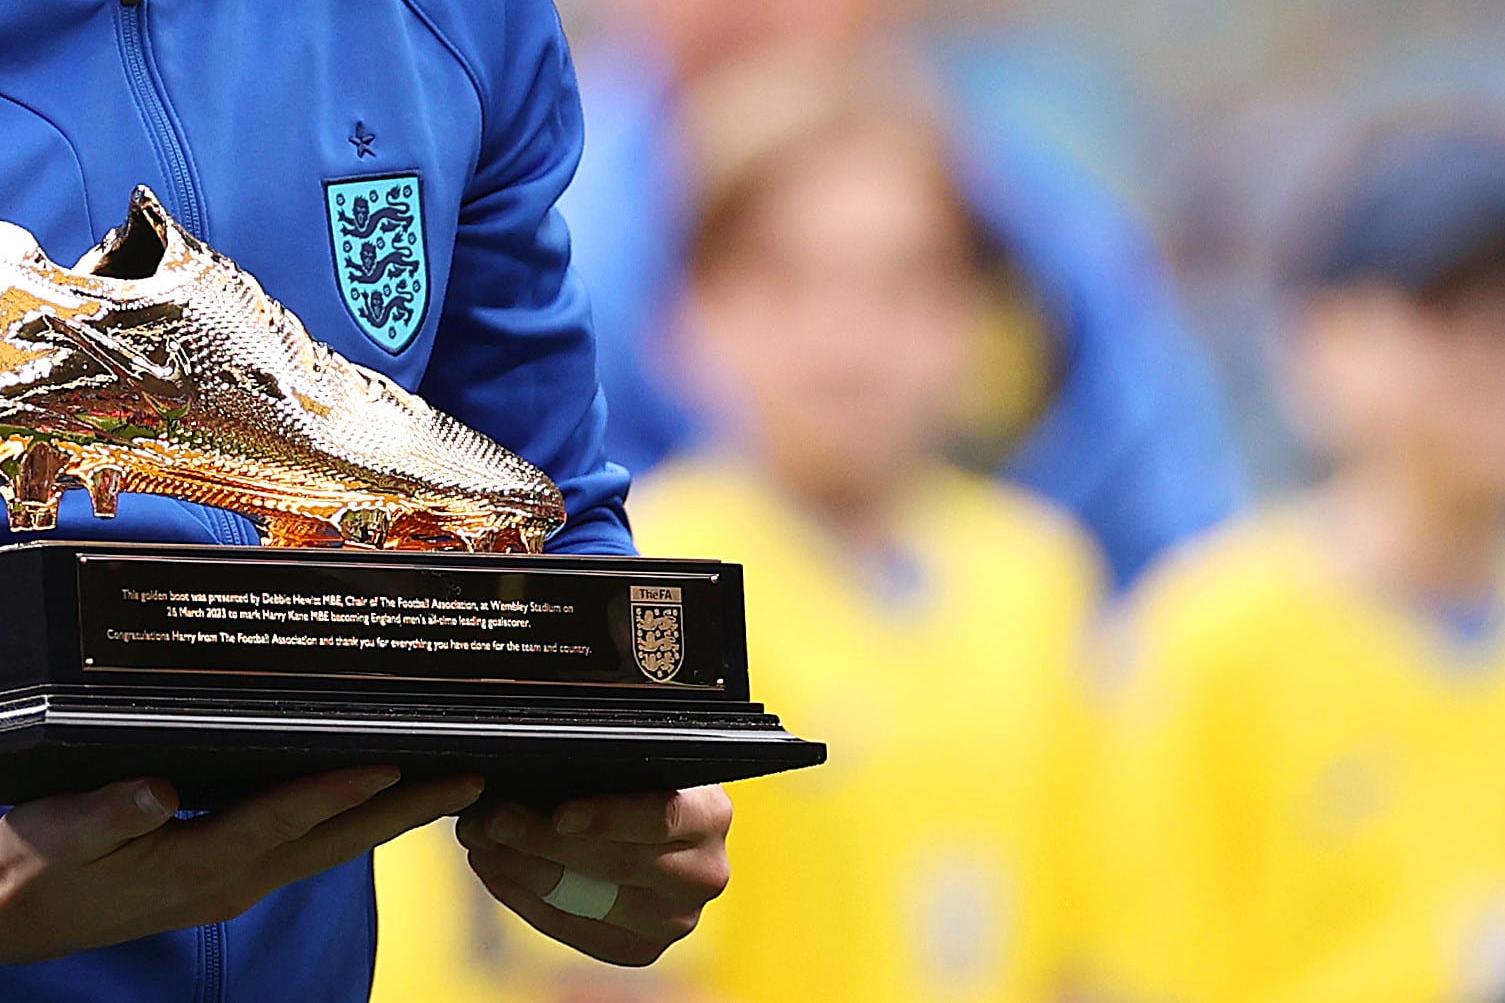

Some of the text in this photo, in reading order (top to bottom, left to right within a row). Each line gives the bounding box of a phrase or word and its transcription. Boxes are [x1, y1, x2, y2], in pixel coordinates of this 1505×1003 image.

[121, 588, 139, 600] This
[140, 589, 168, 603] golden
[169, 590, 190, 602] boot
[190, 593, 208, 603] was
[207, 592, 249, 605] presented
[249, 592, 261, 607] by
[261, 592, 292, 605] Debbie
[344, 595, 368, 607] Chair
[368, 596, 379, 608] of
[379, 596, 396, 608] The
[397, 596, 430, 609] Football
[479, 601, 490, 611] at
[489, 600, 529, 615] Wembley
[529, 601, 562, 613] Stadium
[562, 605, 574, 613] on
[178, 606, 205, 618] March
[205, 607, 227, 620] 2023
[227, 610, 238, 620] to
[239, 609, 262, 621] mark
[261, 608, 287, 623] Harry
[287, 609, 309, 622] Kane
[310, 609, 330, 622] MBE
[330, 610, 370, 626] becoming
[458, 614, 487, 630] leading
[171, 630, 197, 645] Harry
[197, 631, 218, 643] from
[218, 631, 236, 644] The
[237, 632, 270, 645] Football
[271, 632, 318, 646] Association
[318, 635, 335, 646] and
[335, 635, 359, 647] thank
[359, 638, 376, 650] you
[375, 636, 390, 649] for
[390, 637, 433, 652] everything
[433, 641, 449, 652] you
[449, 638, 470, 651] have
[469, 639, 492, 651] done
[491, 640, 506, 651] for
[506, 640, 521, 652] the
[521, 643, 542, 653] team
[543, 642, 558, 653] and
